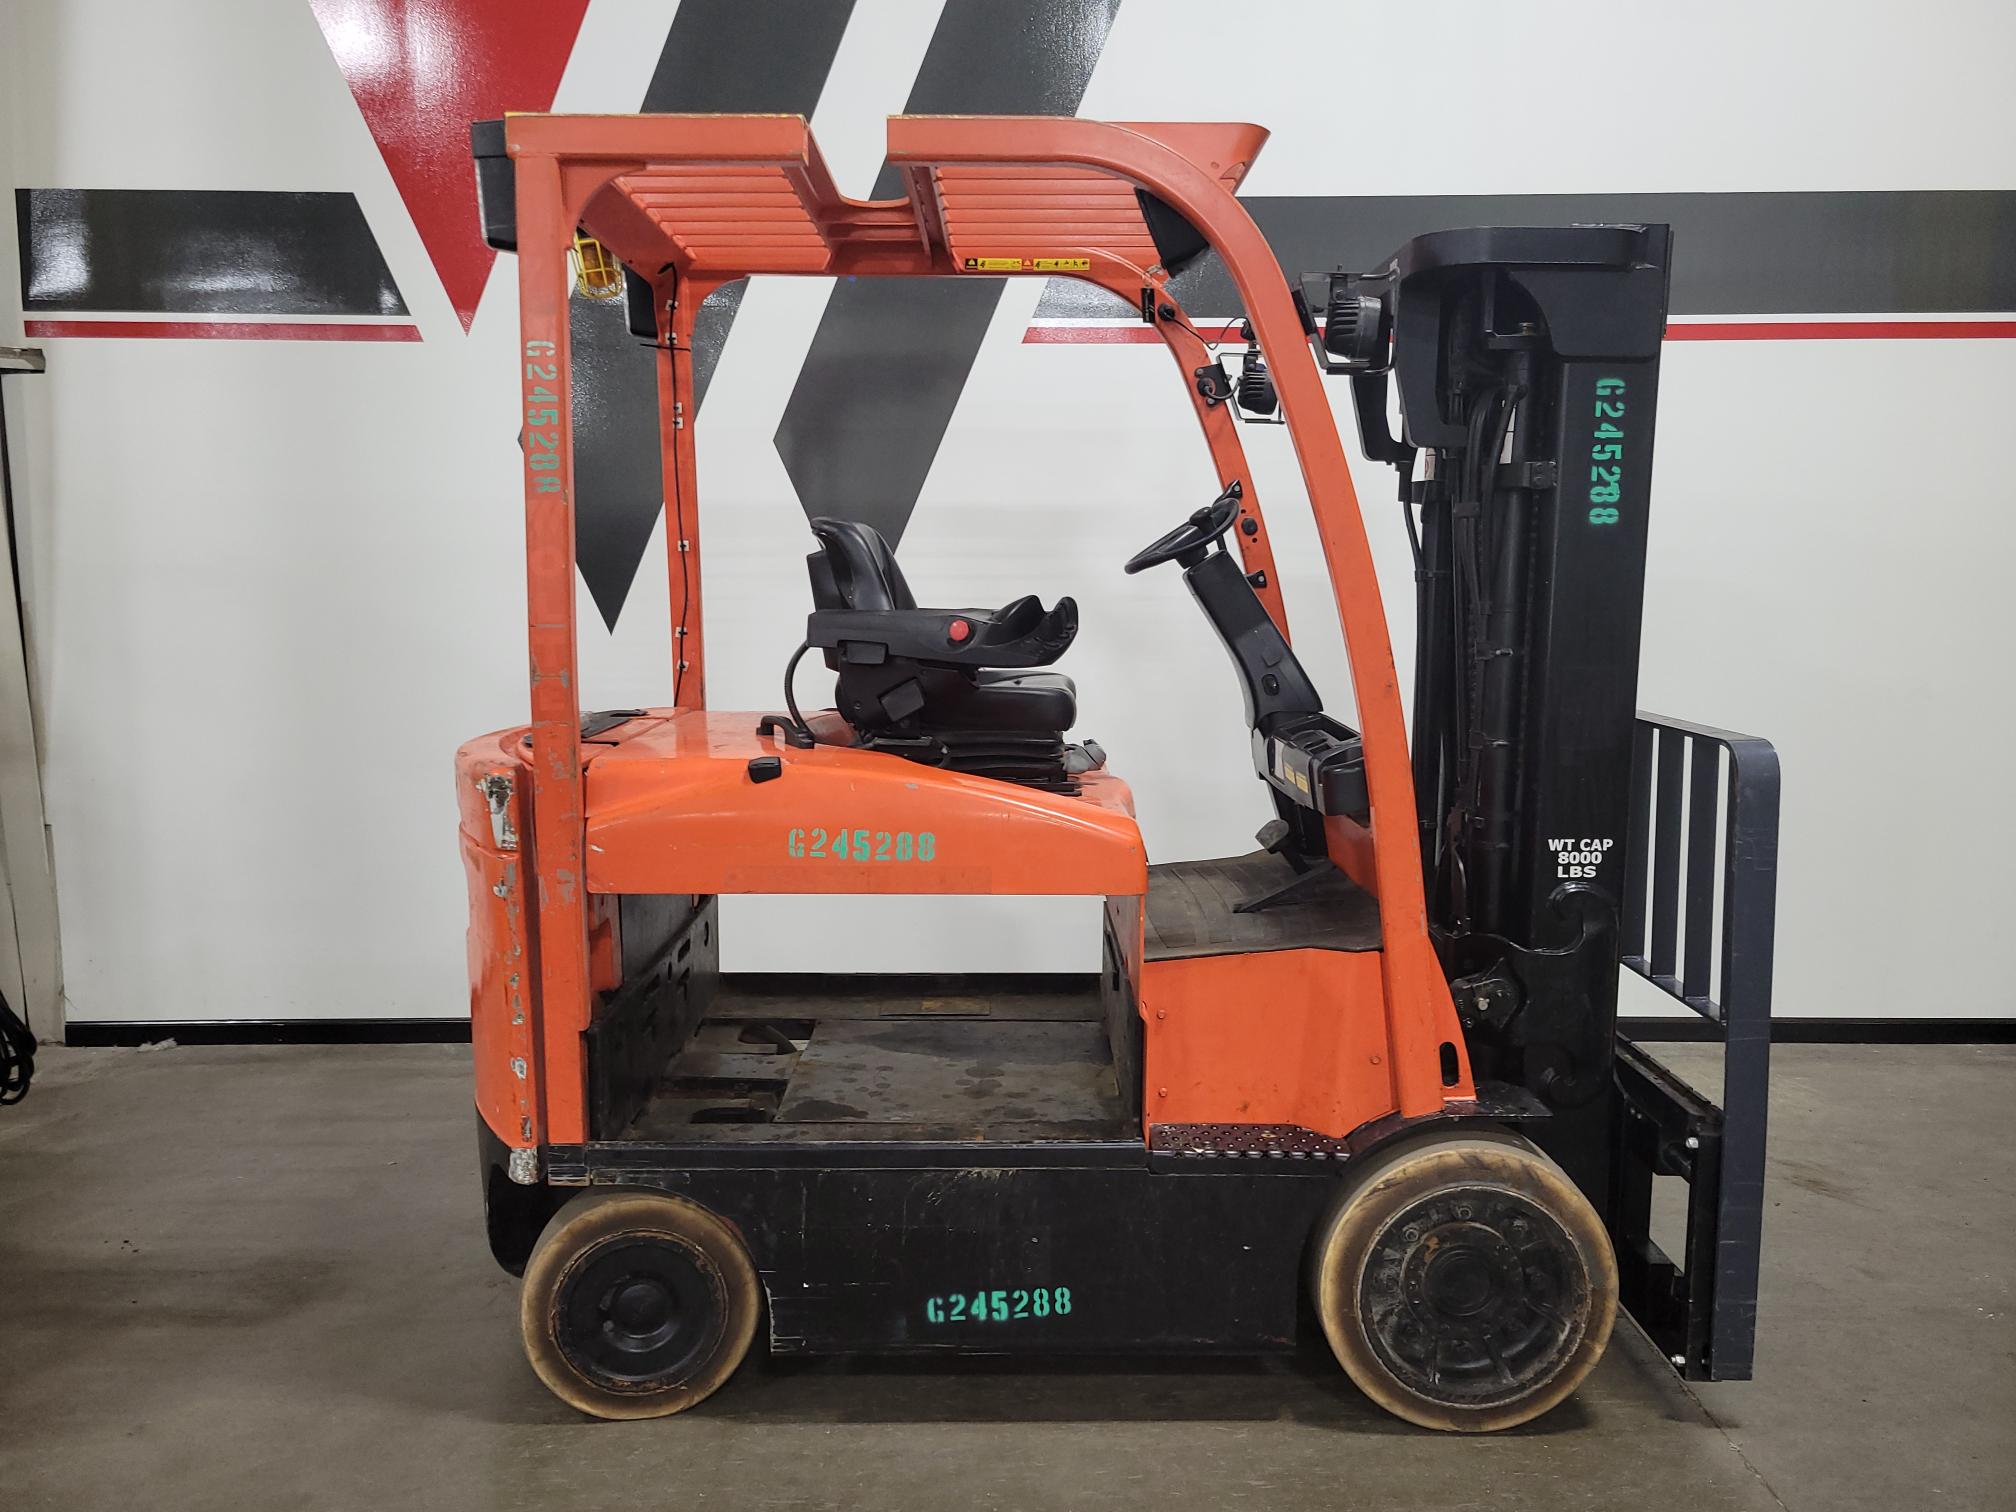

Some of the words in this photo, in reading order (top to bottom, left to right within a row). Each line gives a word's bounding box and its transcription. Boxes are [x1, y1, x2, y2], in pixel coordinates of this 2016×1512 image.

[1588, 378, 1625, 524] G245288
[788, 827, 936, 862] G245288
[1548, 838, 1576, 851] WT
[1579, 838, 1614, 851] CAP
[1557, 851, 1603, 864] 8000
[1557, 865, 1597, 878] LBS
[926, 1286, 1072, 1323] G245288
